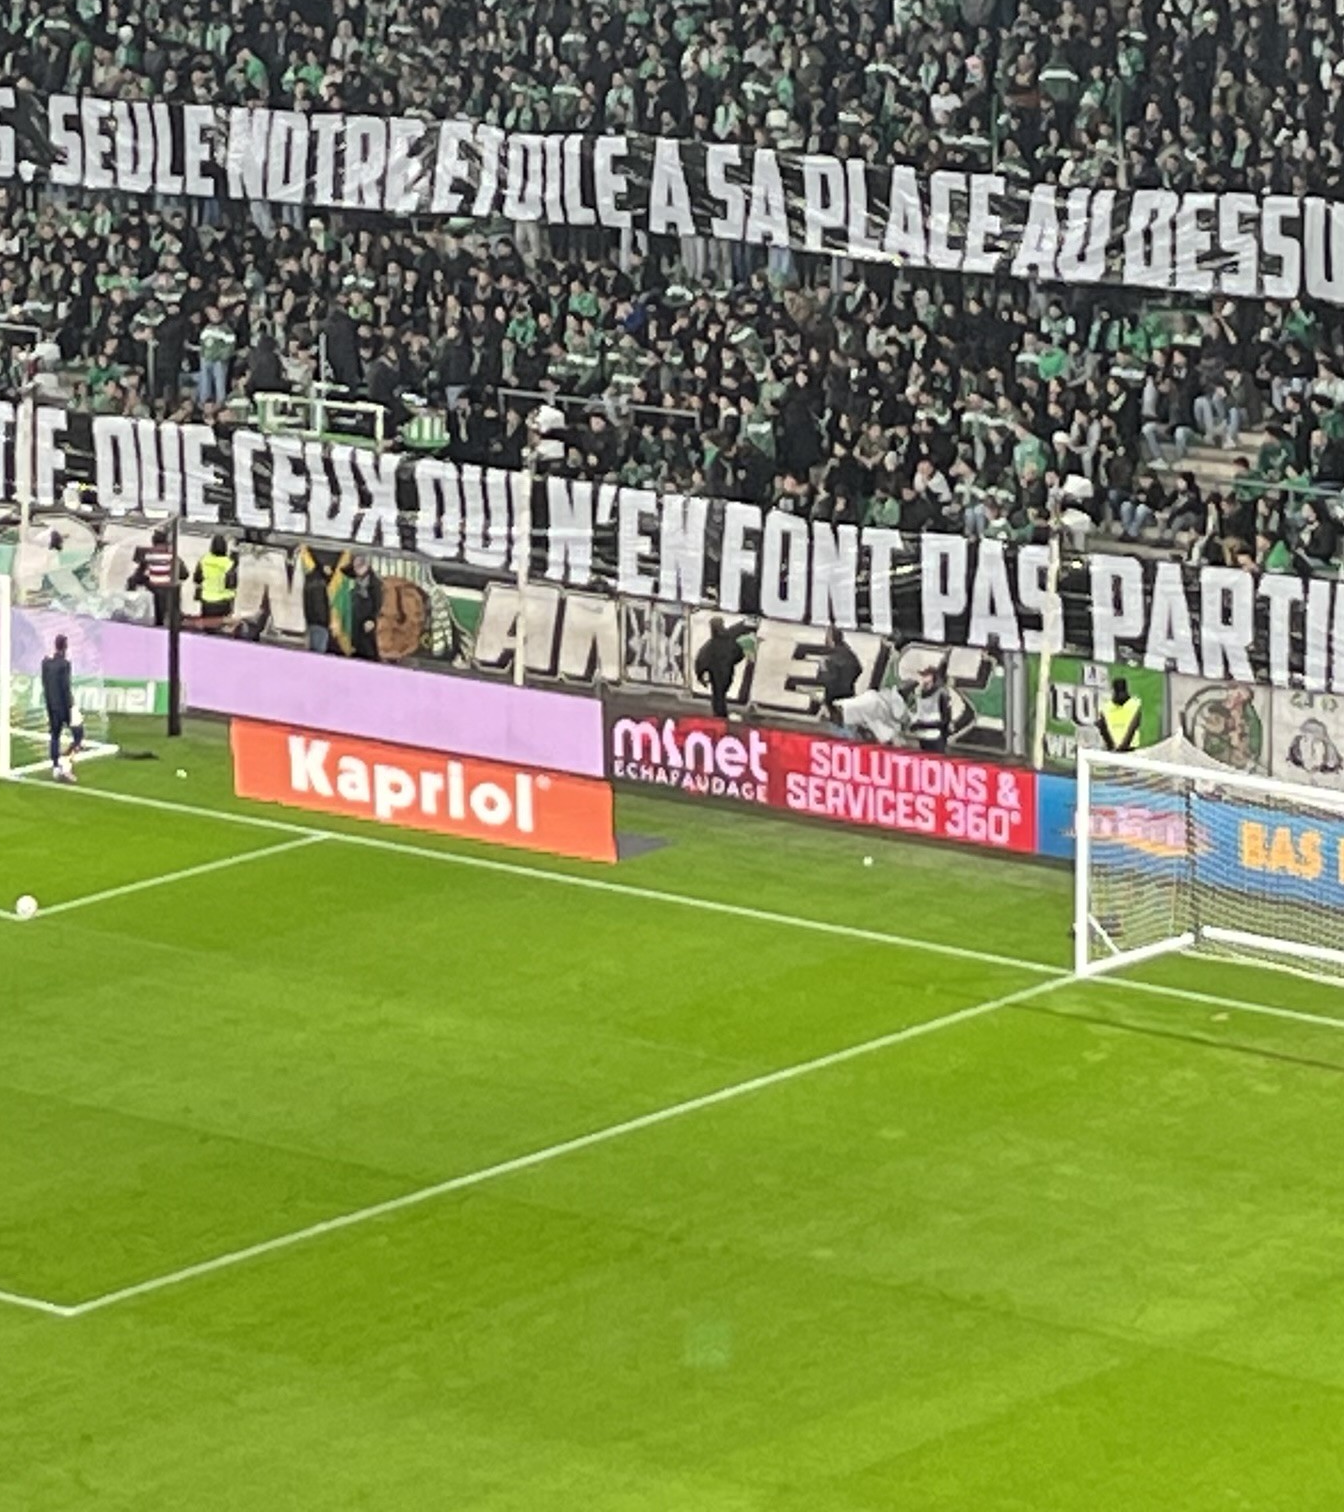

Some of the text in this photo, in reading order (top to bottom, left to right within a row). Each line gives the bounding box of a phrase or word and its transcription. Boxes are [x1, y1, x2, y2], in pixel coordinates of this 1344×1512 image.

[47, 93, 218, 197] SEULE
[226, 105, 426, 216] NOTRE
[430, 119, 633, 229] ETOILE
[648, 136, 696, 236] A
[706, 143, 789, 248] SA
[803, 155, 1006, 272] PLACE
[1010, 184, 1117, 284] AU
[93, 415, 220, 523] QUE
[233, 430, 401, 549] CEUX
[544, 476, 709, 606] N'EN
[719, 500, 906, 635] FONT
[920, 532, 1064, 653] PAS
[31, 674, 156, 714] hmmel
[287, 734, 536, 833] Kapriol
[786, 772, 936, 833] SERVICES
[810, 741, 988, 808] SOLUTIONS
[996, 771, 1022, 809] &
[1238, 819, 1326, 881] BAS
